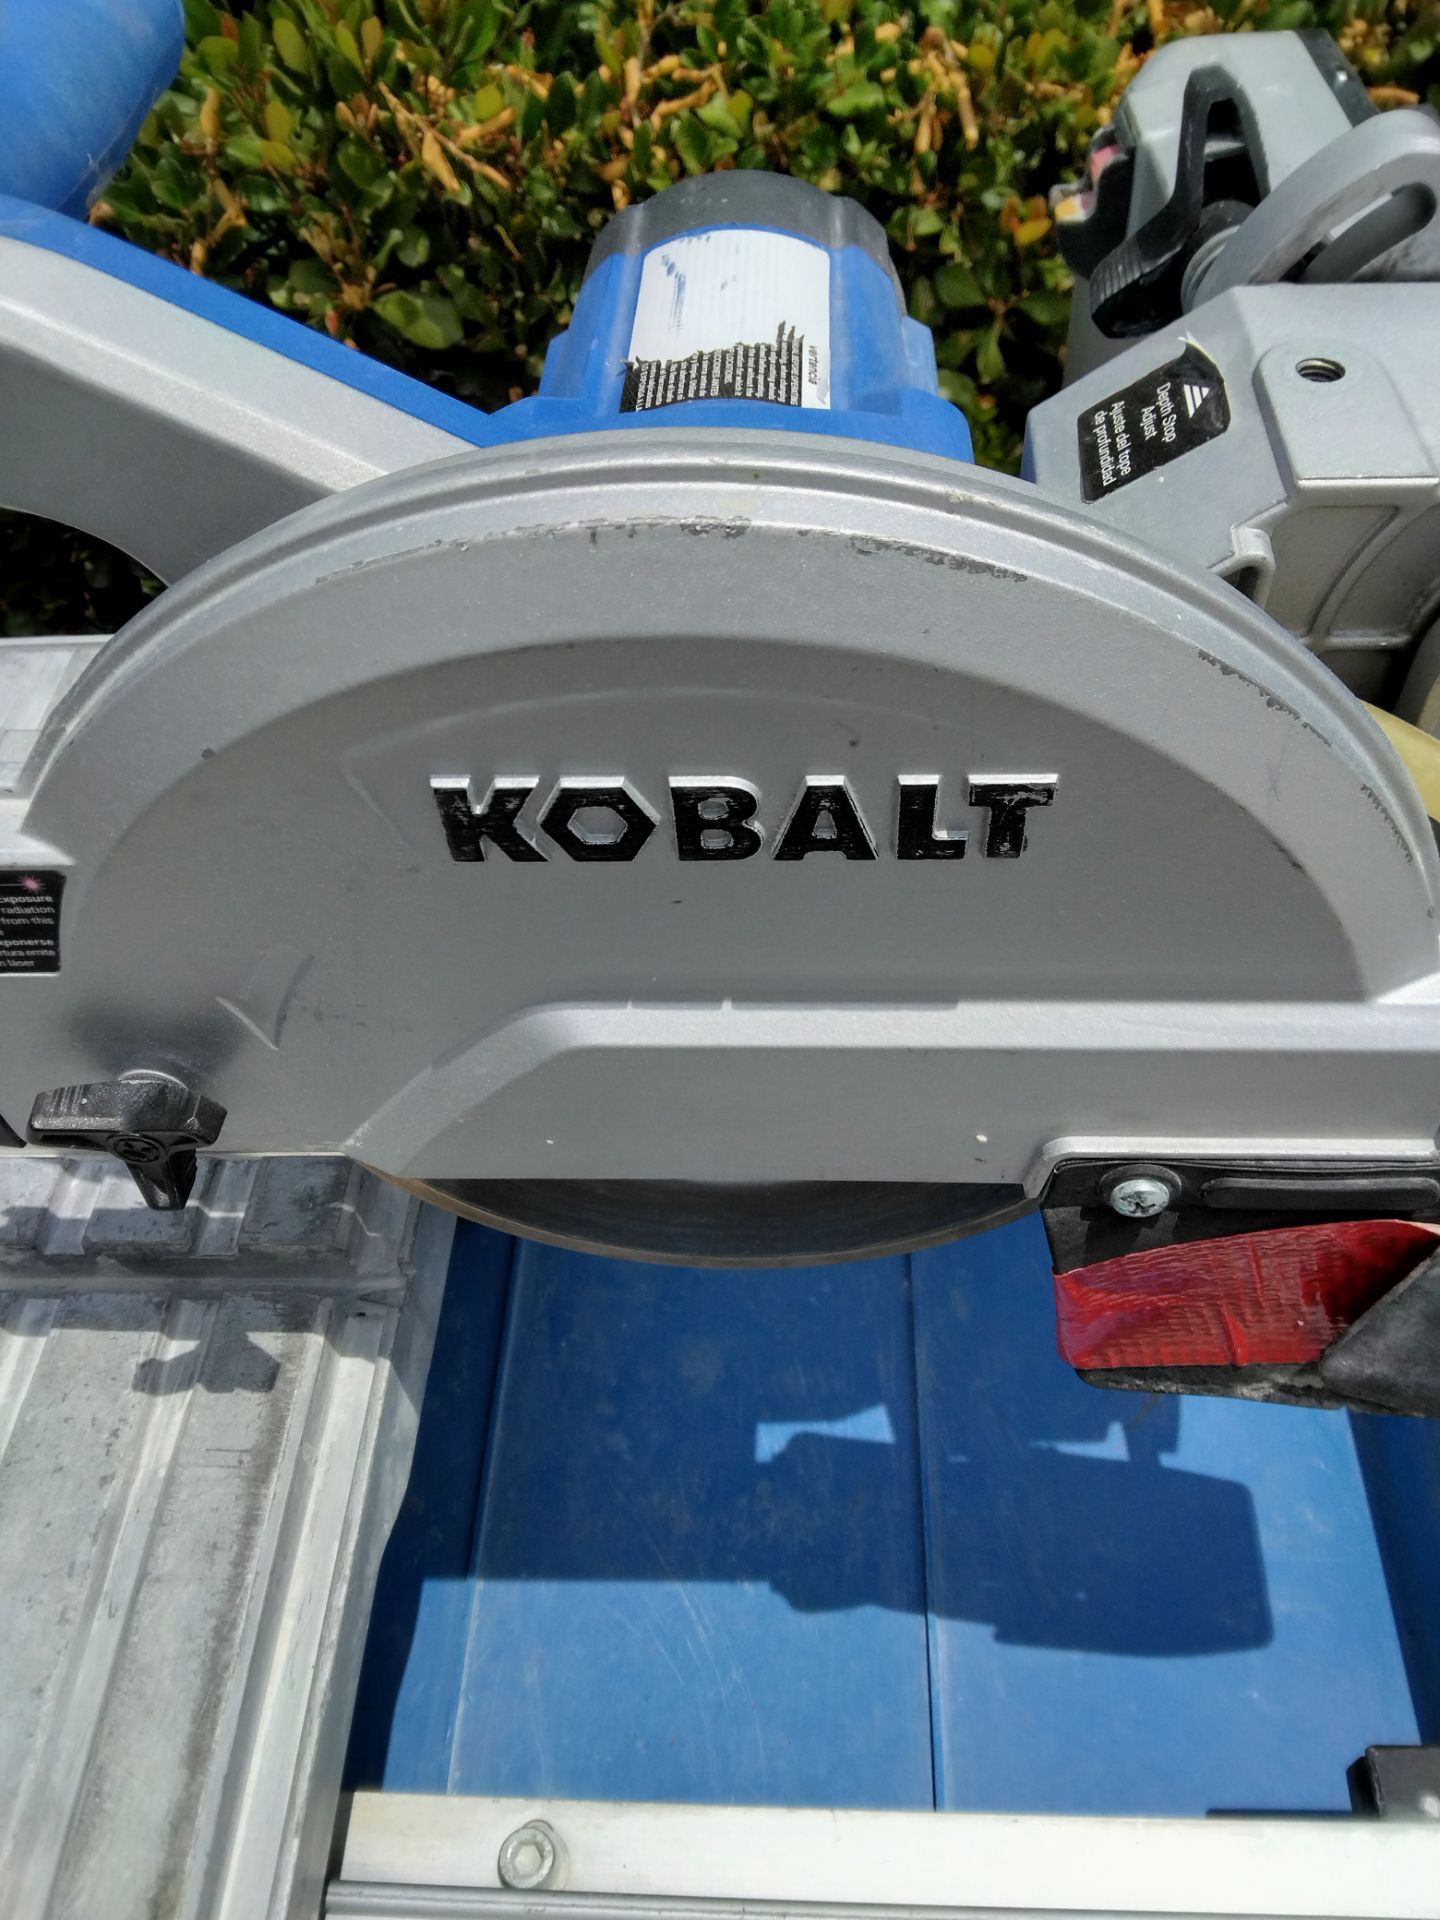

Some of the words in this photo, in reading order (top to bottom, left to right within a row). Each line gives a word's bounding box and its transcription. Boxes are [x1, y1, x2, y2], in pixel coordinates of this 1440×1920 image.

[711, 378, 720, 396] ANTES
[1156, 382, 1174, 418] Depth
[1094, 410, 1108, 426] de
[1109, 400, 1126, 434] Ajuste
[1140, 406, 1158, 440] Adjust
[1162, 414, 1176, 442] Stop
[1092, 424, 1116, 486] profundidad
[1116, 433, 1131, 451] del
[1116, 449, 1131, 476] tope
[429, 775, 1059, 862] KOBALT
[31, 916, 54, 924] this
